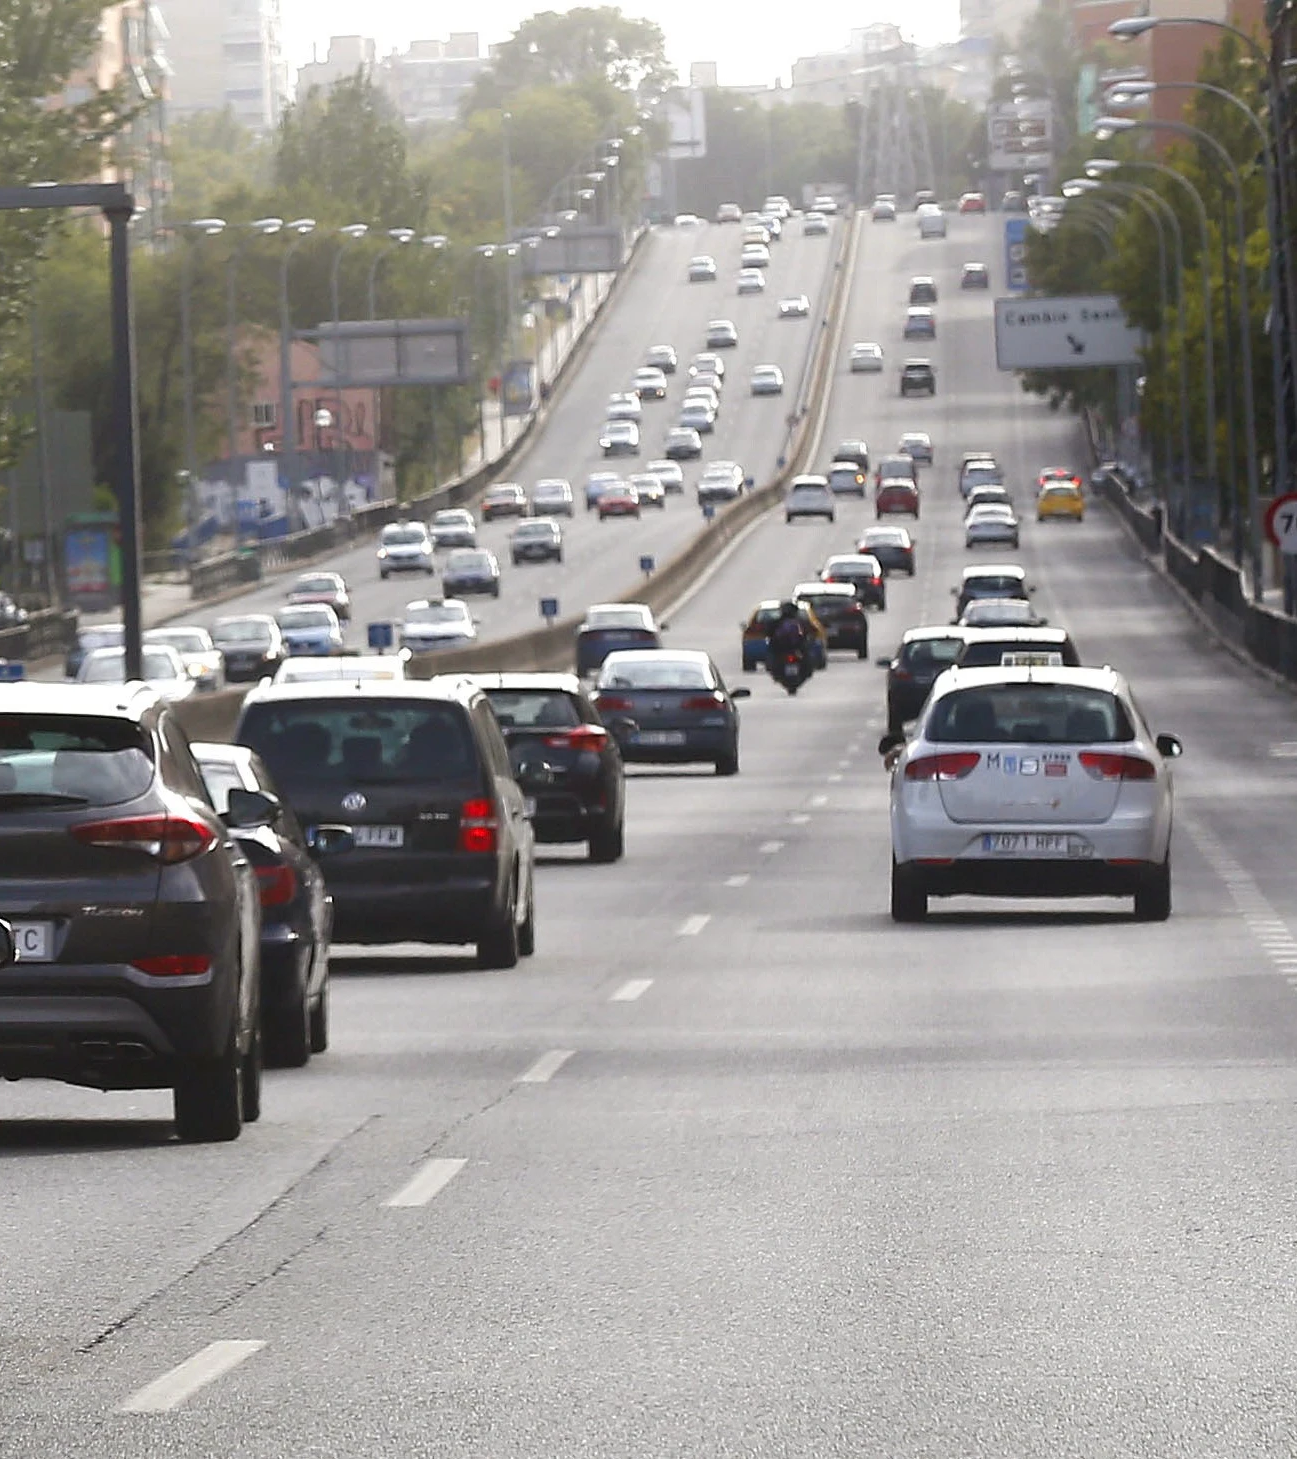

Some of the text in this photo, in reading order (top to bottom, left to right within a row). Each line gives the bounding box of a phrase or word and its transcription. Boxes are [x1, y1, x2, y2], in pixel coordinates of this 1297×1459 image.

[1005, 310, 1067, 326] Cambio
[1281, 512, 1297, 534] 7
[987, 751, 1000, 769] M
